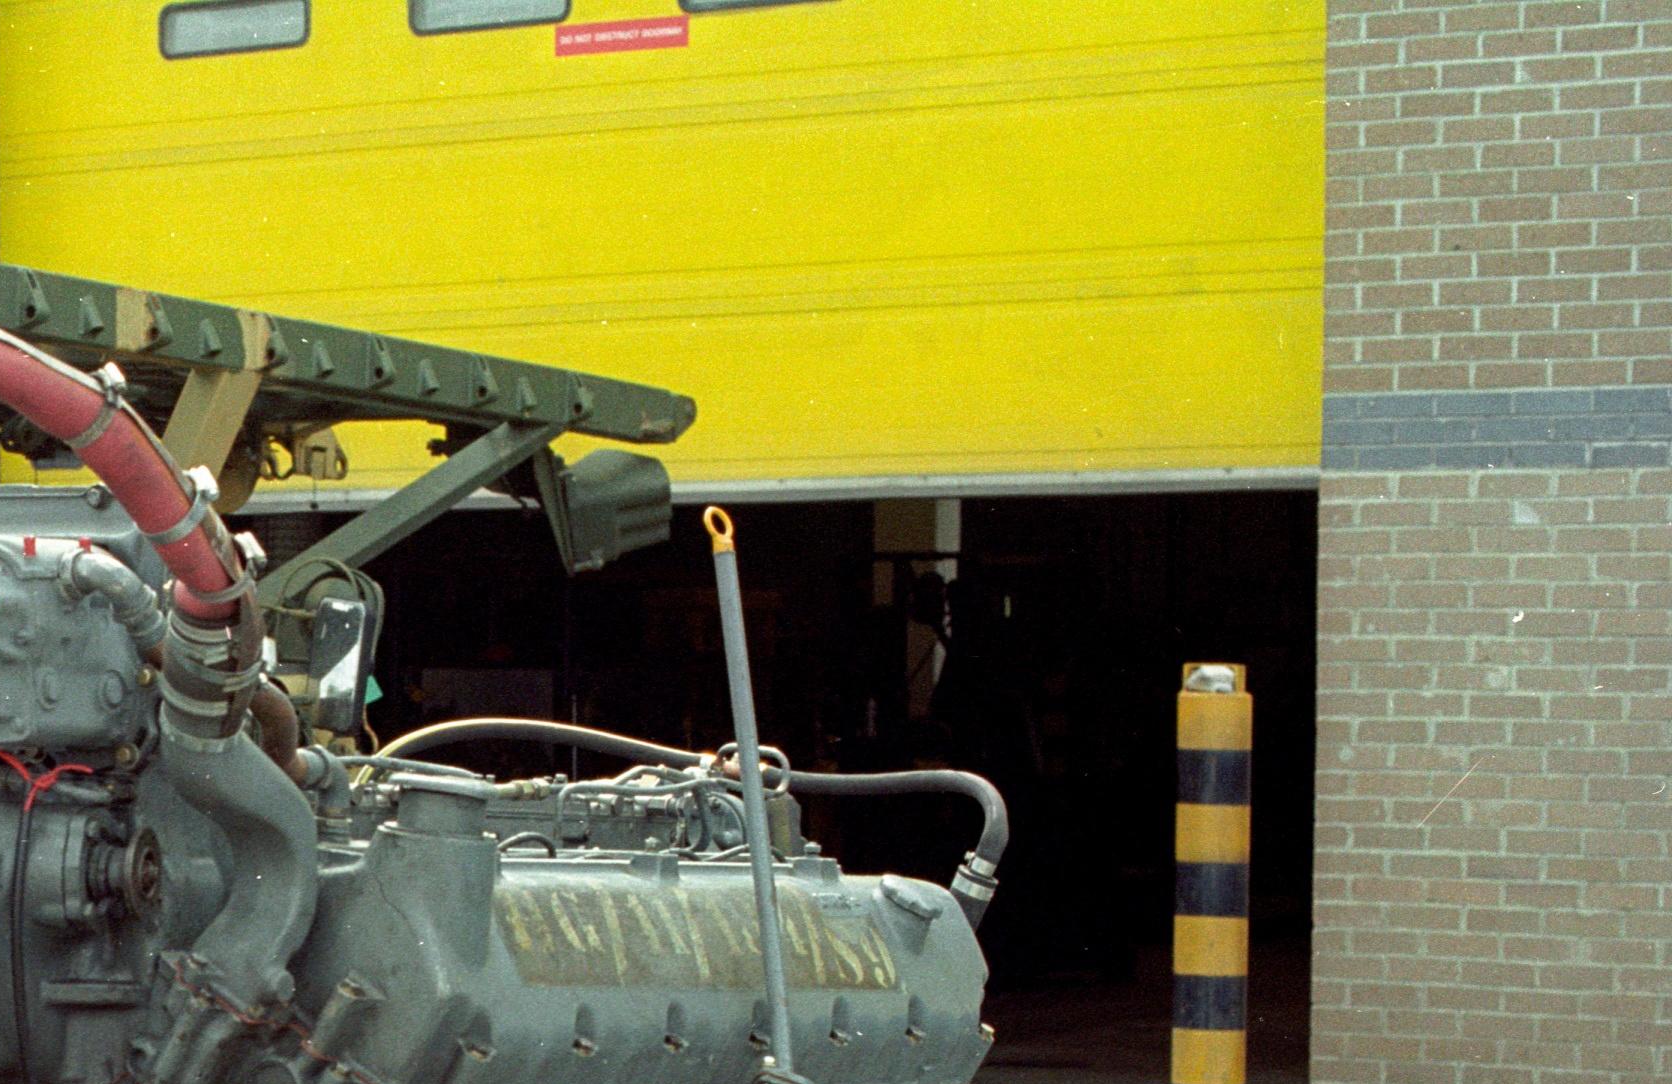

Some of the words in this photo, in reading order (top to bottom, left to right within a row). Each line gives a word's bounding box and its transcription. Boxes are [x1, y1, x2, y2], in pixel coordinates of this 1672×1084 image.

[560, 35, 573, 45] DO
[575, 33, 592, 44] NOT
[594, 29, 640, 42] OBSTRUCT
